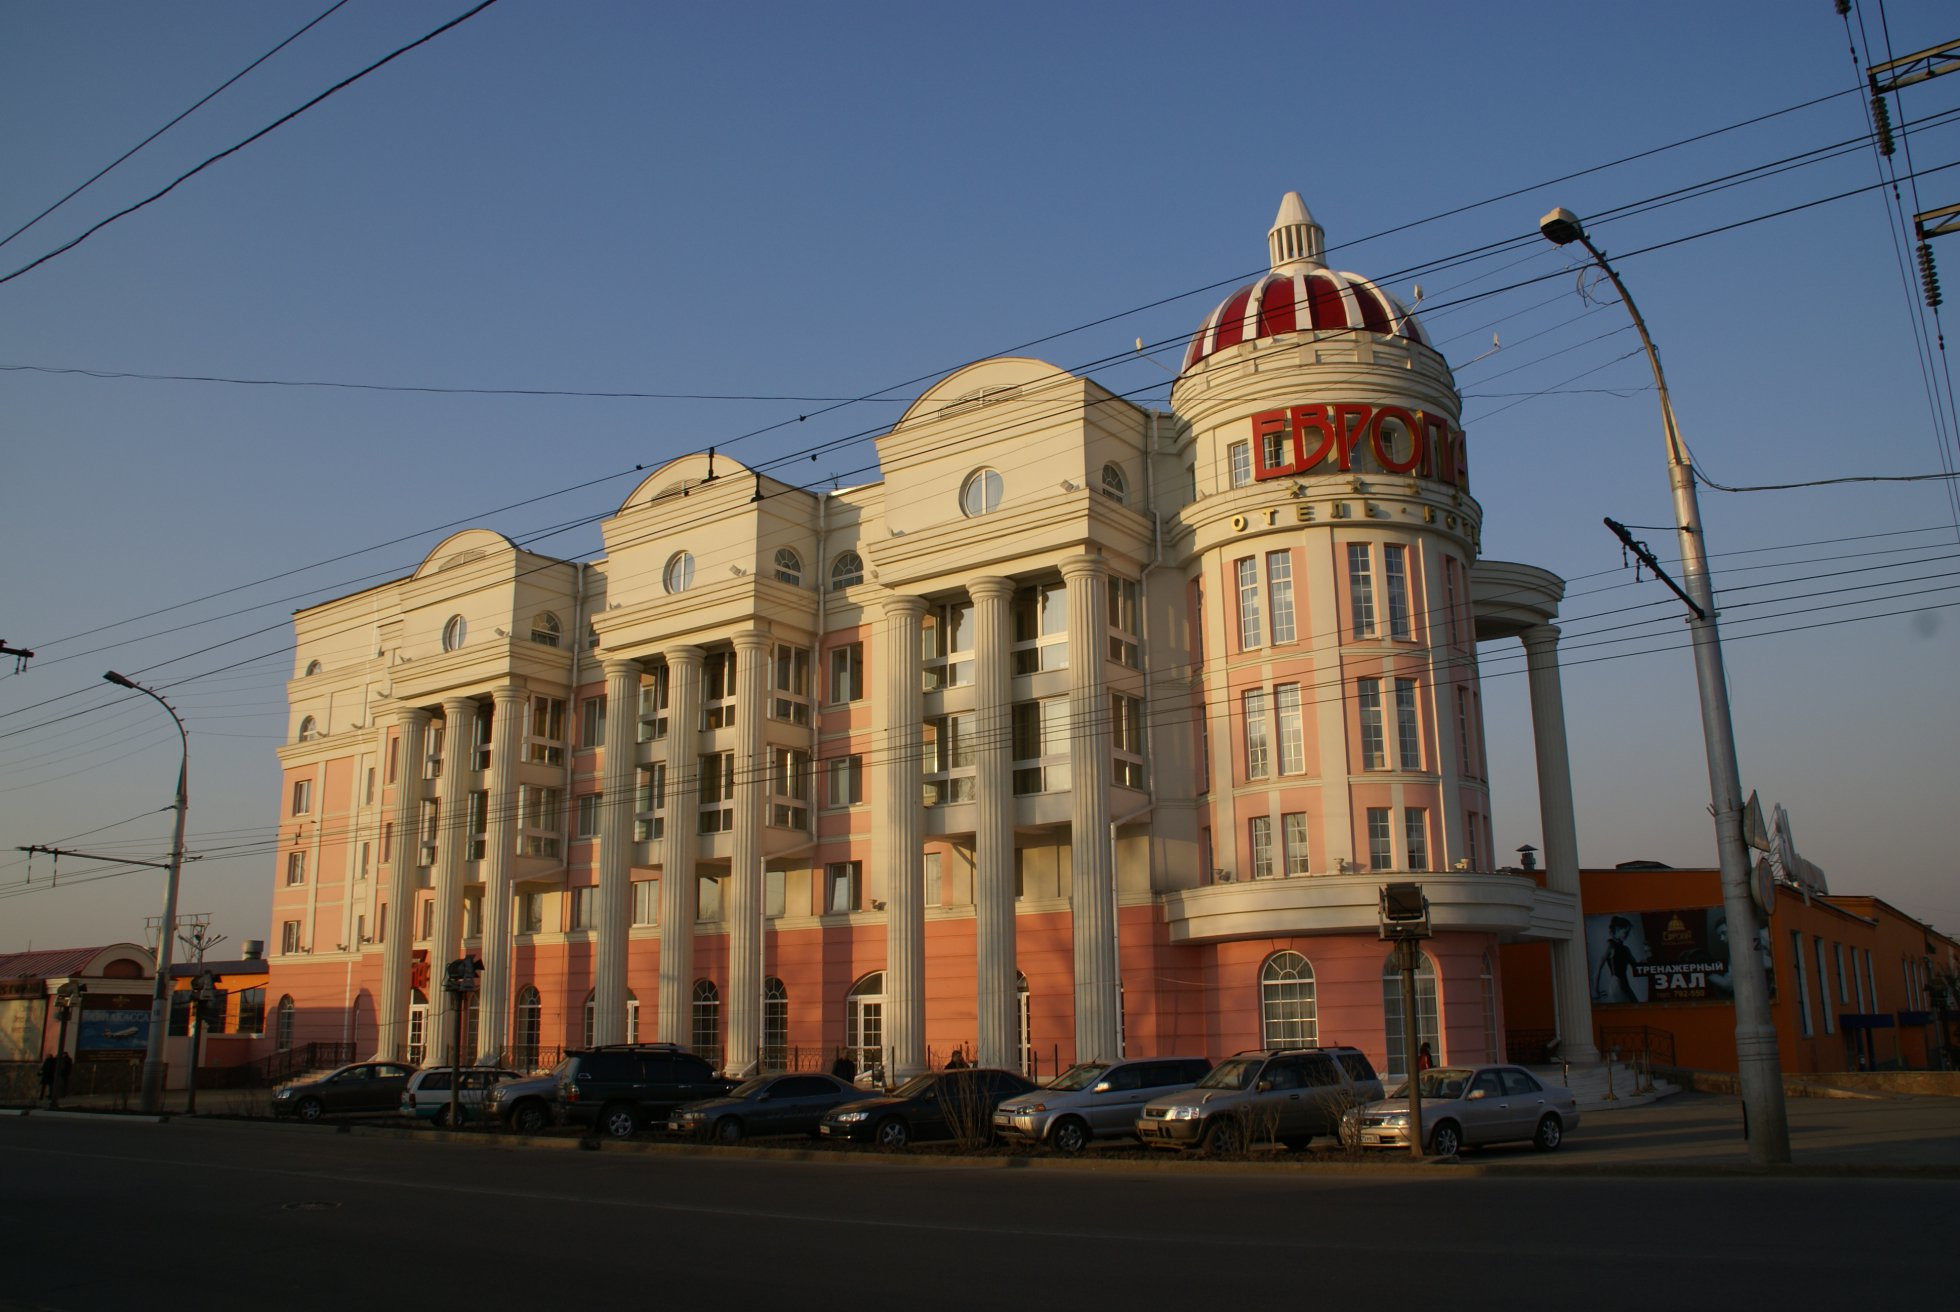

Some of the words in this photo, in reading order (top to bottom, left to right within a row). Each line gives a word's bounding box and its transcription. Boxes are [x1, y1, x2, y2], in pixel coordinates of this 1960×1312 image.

[1251, 403, 1470, 496] ЕВРОПА
[1232, 498, 1377, 532] ОТЕЛЬ
[1636, 962, 1724, 975] ТРЕНАЖЕРНЫЙ
[1654, 973, 1706, 989] ЗАЛ
